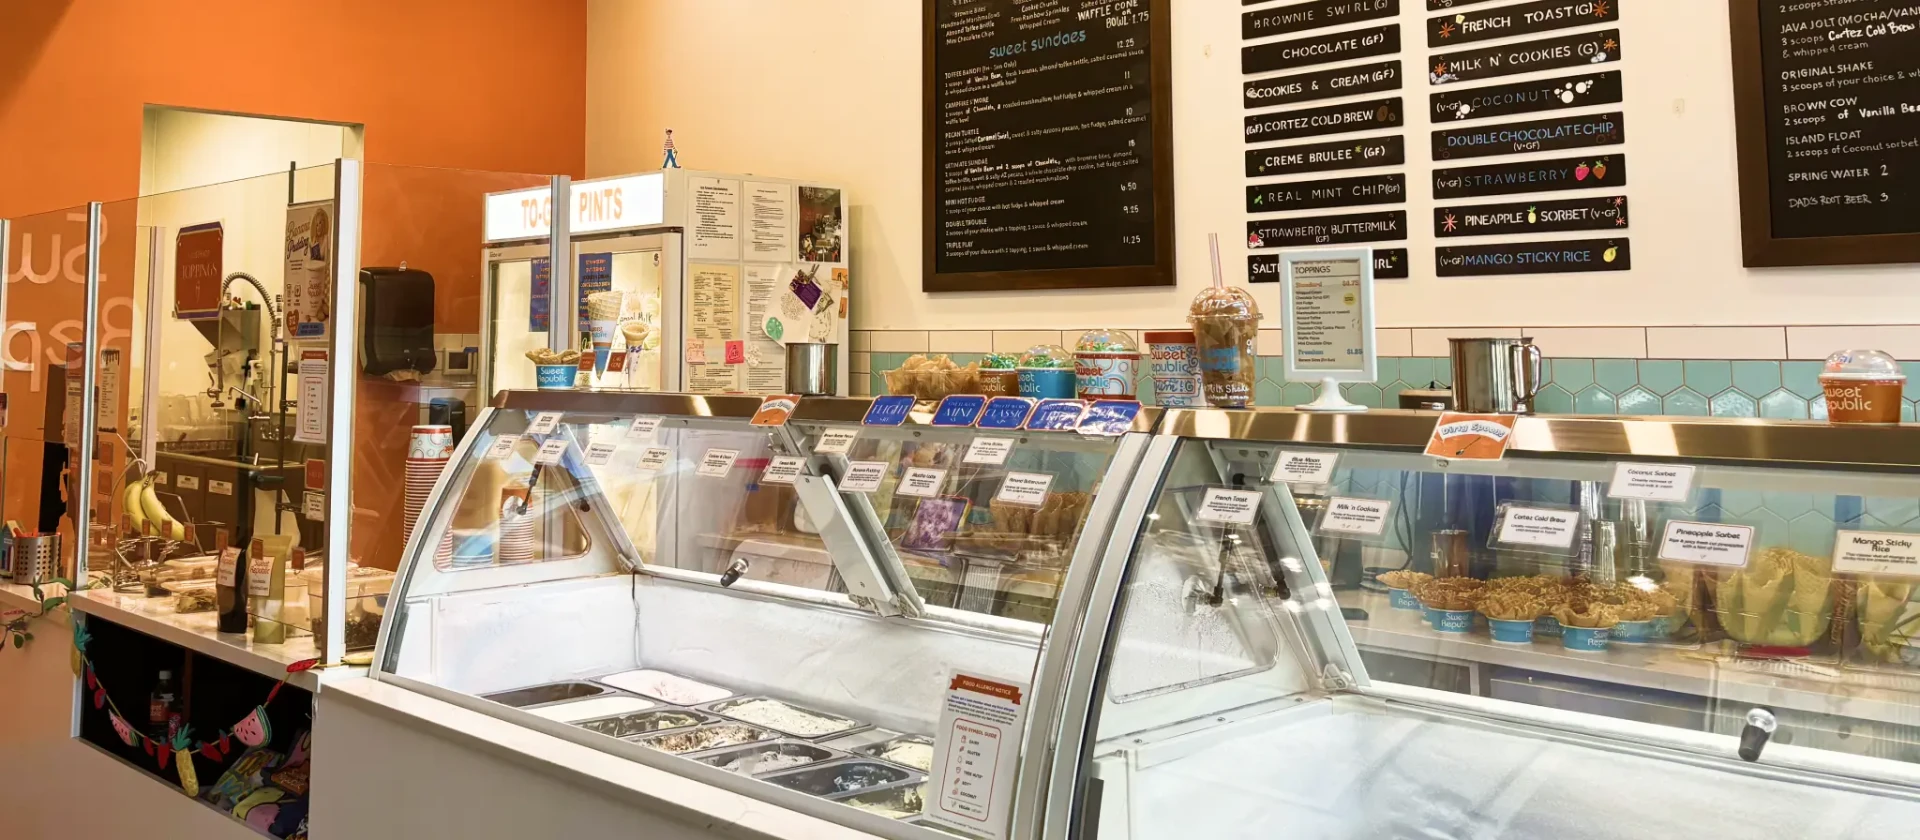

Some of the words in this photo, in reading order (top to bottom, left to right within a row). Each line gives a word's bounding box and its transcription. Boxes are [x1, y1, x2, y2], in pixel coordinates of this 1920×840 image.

[1077, 5, 1111, 21] WAFFLE
[1115, 0, 1138, 11] CONE
[1254, 10, 1315, 29] BROWNIE
[1326, 1, 1371, 17] SWIRL
[1788, 1, 1822, 12] scoops
[1106, 16, 1128, 28] BOWL
[1132, 11, 1149, 24] 1.75
[1462, 16, 1511, 34] FRENCH
[1780, 22, 1807, 34] JAVA
[1809, 17, 1836, 30] JOLT
[1782, 37, 1787, 46] 3
[1790, 34, 1825, 45] scoops
[1828, 29, 1863, 41] Cortez
[1865, 23, 1887, 37] Cold
[1887, 21, 1915, 35] Brew
[989, 40, 1027, 59] sweet
[1031, 30, 1086, 52] sundaes
[1117, 37, 1135, 49] 12.25
[1282, 39, 1358, 59] CHOCOLATE
[1362, 33, 1384, 47] (GF)
[1793, 43, 1836, 57] whipped
[1838, 41, 1869, 51] cream
[1450, 58, 1482, 73] MILK
[1509, 46, 1571, 65] COOKIES
[1577, 41, 1600, 57] (G)
[1781, 66, 1835, 81] ORIGINAL
[1837, 61, 1874, 74] SHAKE
[1257, 83, 1302, 99] COOKIES
[1311, 80, 1319, 91] &
[1330, 74, 1370, 89] CREAM
[1372, 68, 1394, 83] (GF)
[1782, 84, 1788, 92] 3
[1790, 80, 1824, 92] scoops
[1825, 78, 1835, 88] of
[1837, 77, 1860, 88] your
[1863, 72, 1895, 84] choice
[1472, 89, 1550, 109] COCONUT
[1783, 101, 1827, 114] BROWN
[1829, 96, 1858, 109] COW
[1246, 123, 1263, 136] (GF)
[1264, 117, 1309, 133] CORTEZ
[1311, 114, 1342, 127] COLD
[1343, 110, 1374, 124] BREW
[1784, 117, 1790, 126] 2
[1793, 115, 1826, 125] scoops
[1837, 109, 1849, 120] of
[1859, 105, 1896, 118] Vanilla
[1447, 132, 1498, 147] DOUBLE
[1499, 124, 1582, 142] CHOCOLATE
[1583, 121, 1614, 135] CHIP
[1786, 133, 1825, 146] ISLAND
[1828, 129, 1862, 142] FLOAT
[1265, 154, 1304, 167] CREME
[1309, 149, 1353, 163] BRULEE
[1363, 145, 1386, 159] (GF)
[1787, 150, 1793, 158] 2
[1795, 147, 1829, 158] scoops
[1831, 144, 1842, 154] of
[1842, 142, 1884, 153] Coconut
[1885, 137, 1919, 149] sorbet
[1464, 168, 1568, 187] STRAWBERRY
[1788, 170, 1828, 182] SPRING
[1831, 168, 1870, 179] WATER
[1880, 164, 1889, 176] 2
[1268, 191, 1302, 202] REAL
[1312, 188, 1342, 199] MINT
[1820, 195, 1841, 204] ROOT
[1843, 194, 1872, 204] BEER
[1880, 192, 1889, 202] 3
[579, 187, 623, 223] PINTS
[945, 220, 965, 228] DOUBLE
[1464, 212, 1524, 226] PINEAPPLE
[1540, 208, 1588, 222] SORBET
[1258, 226, 1328, 239] STRAWBERRY
[1331, 220, 1397, 235] BUTTERMILK
[1465, 253, 1513, 266] MANGO
[1516, 251, 1560, 264] STICKY
[1563, 250, 1591, 262] RICE
[182, 263, 217, 279] TOPPINGS
[1295, 265, 1331, 274] TOPPINGS
[538, 375, 567, 384] Republic
[541, 367, 564, 375] Sweet
[872, 404, 909, 415] FLIGHT
[984, 409, 1023, 418] CLASSIC
[1442, 424, 1469, 436] Dirty
[1215, 494, 1233, 502] French
[1357, 505, 1379, 513] Cookies
[1514, 513, 1533, 521] Cortez
[1676, 528, 1714, 538] Pineapple
[1715, 531, 1741, 539] Sorbet
[1853, 536, 1884, 546] Mango
[1886, 537, 1912, 548] Sticky
[1871, 545, 1890, 553] Rice
[976, 683, 995, 692] ALLERGY
